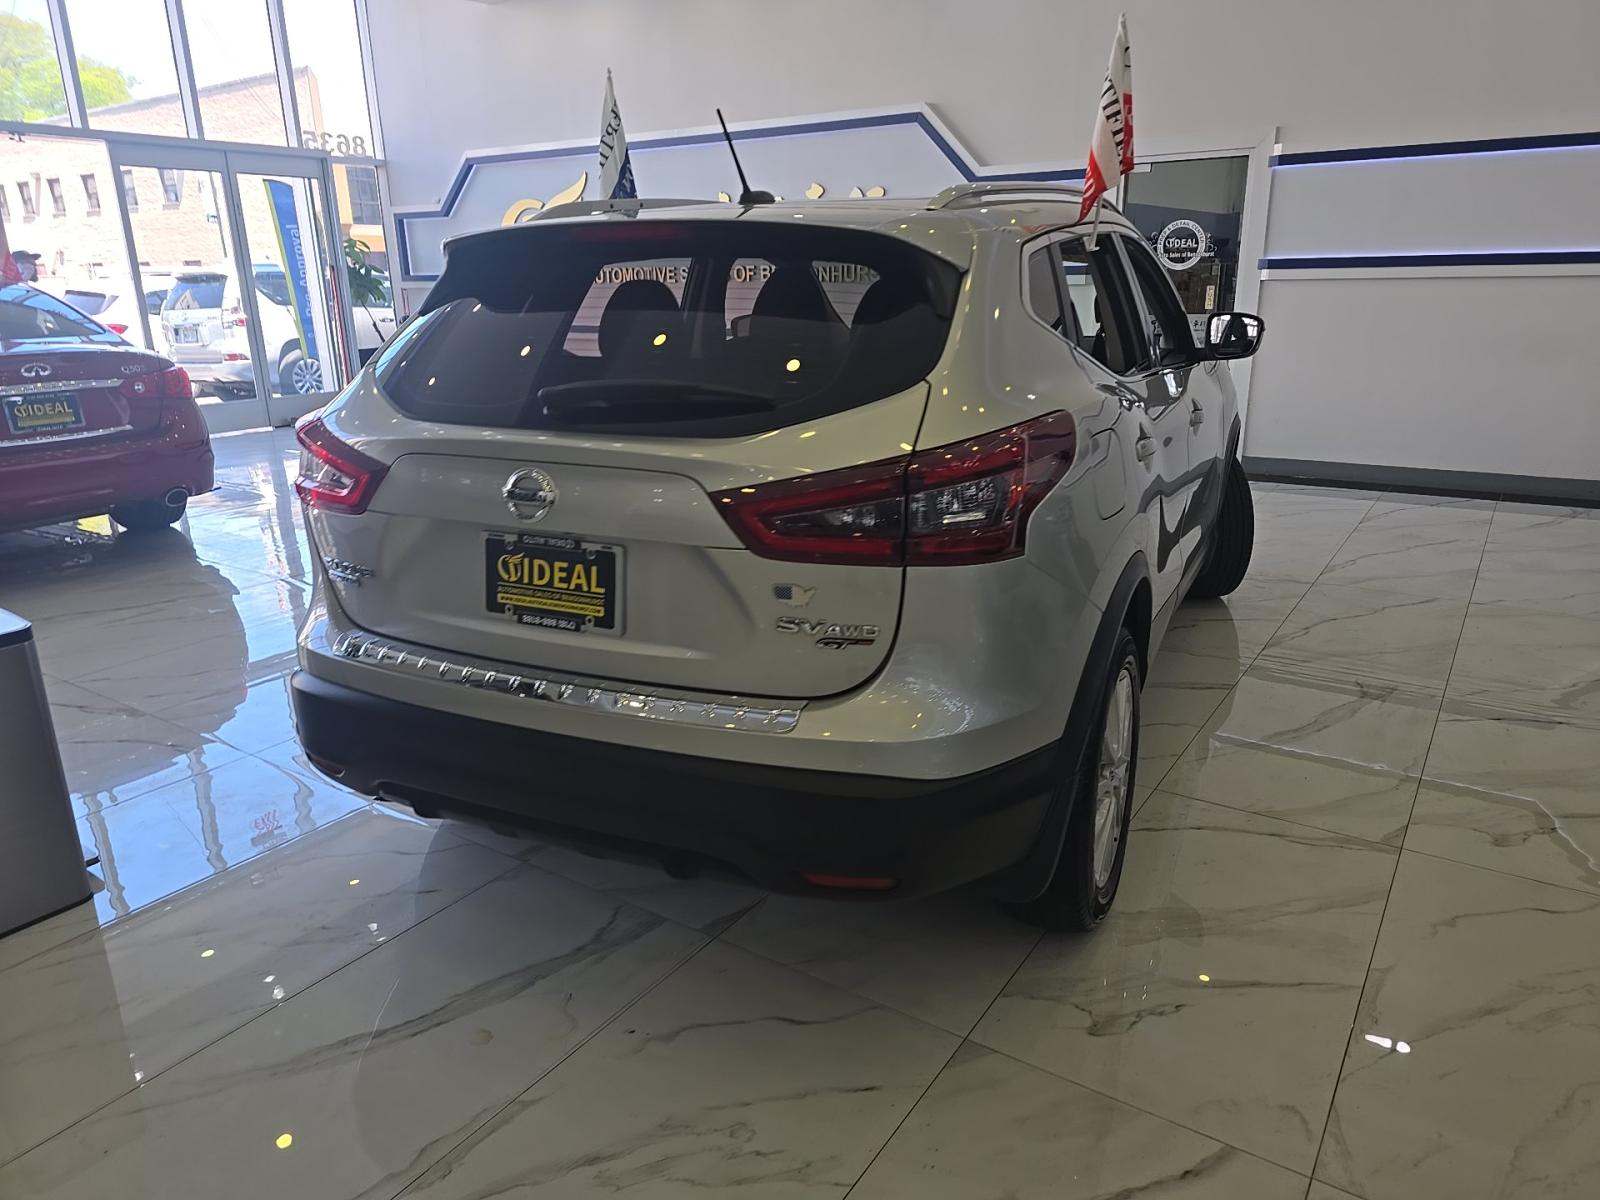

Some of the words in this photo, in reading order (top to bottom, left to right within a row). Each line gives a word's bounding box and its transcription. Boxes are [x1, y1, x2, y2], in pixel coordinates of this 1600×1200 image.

[595, 265, 677, 284] UTOMOTIVE
[733, 264, 756, 283] OF
[523, 557, 605, 594] IDEAL
[776, 615, 827, 635] SV
